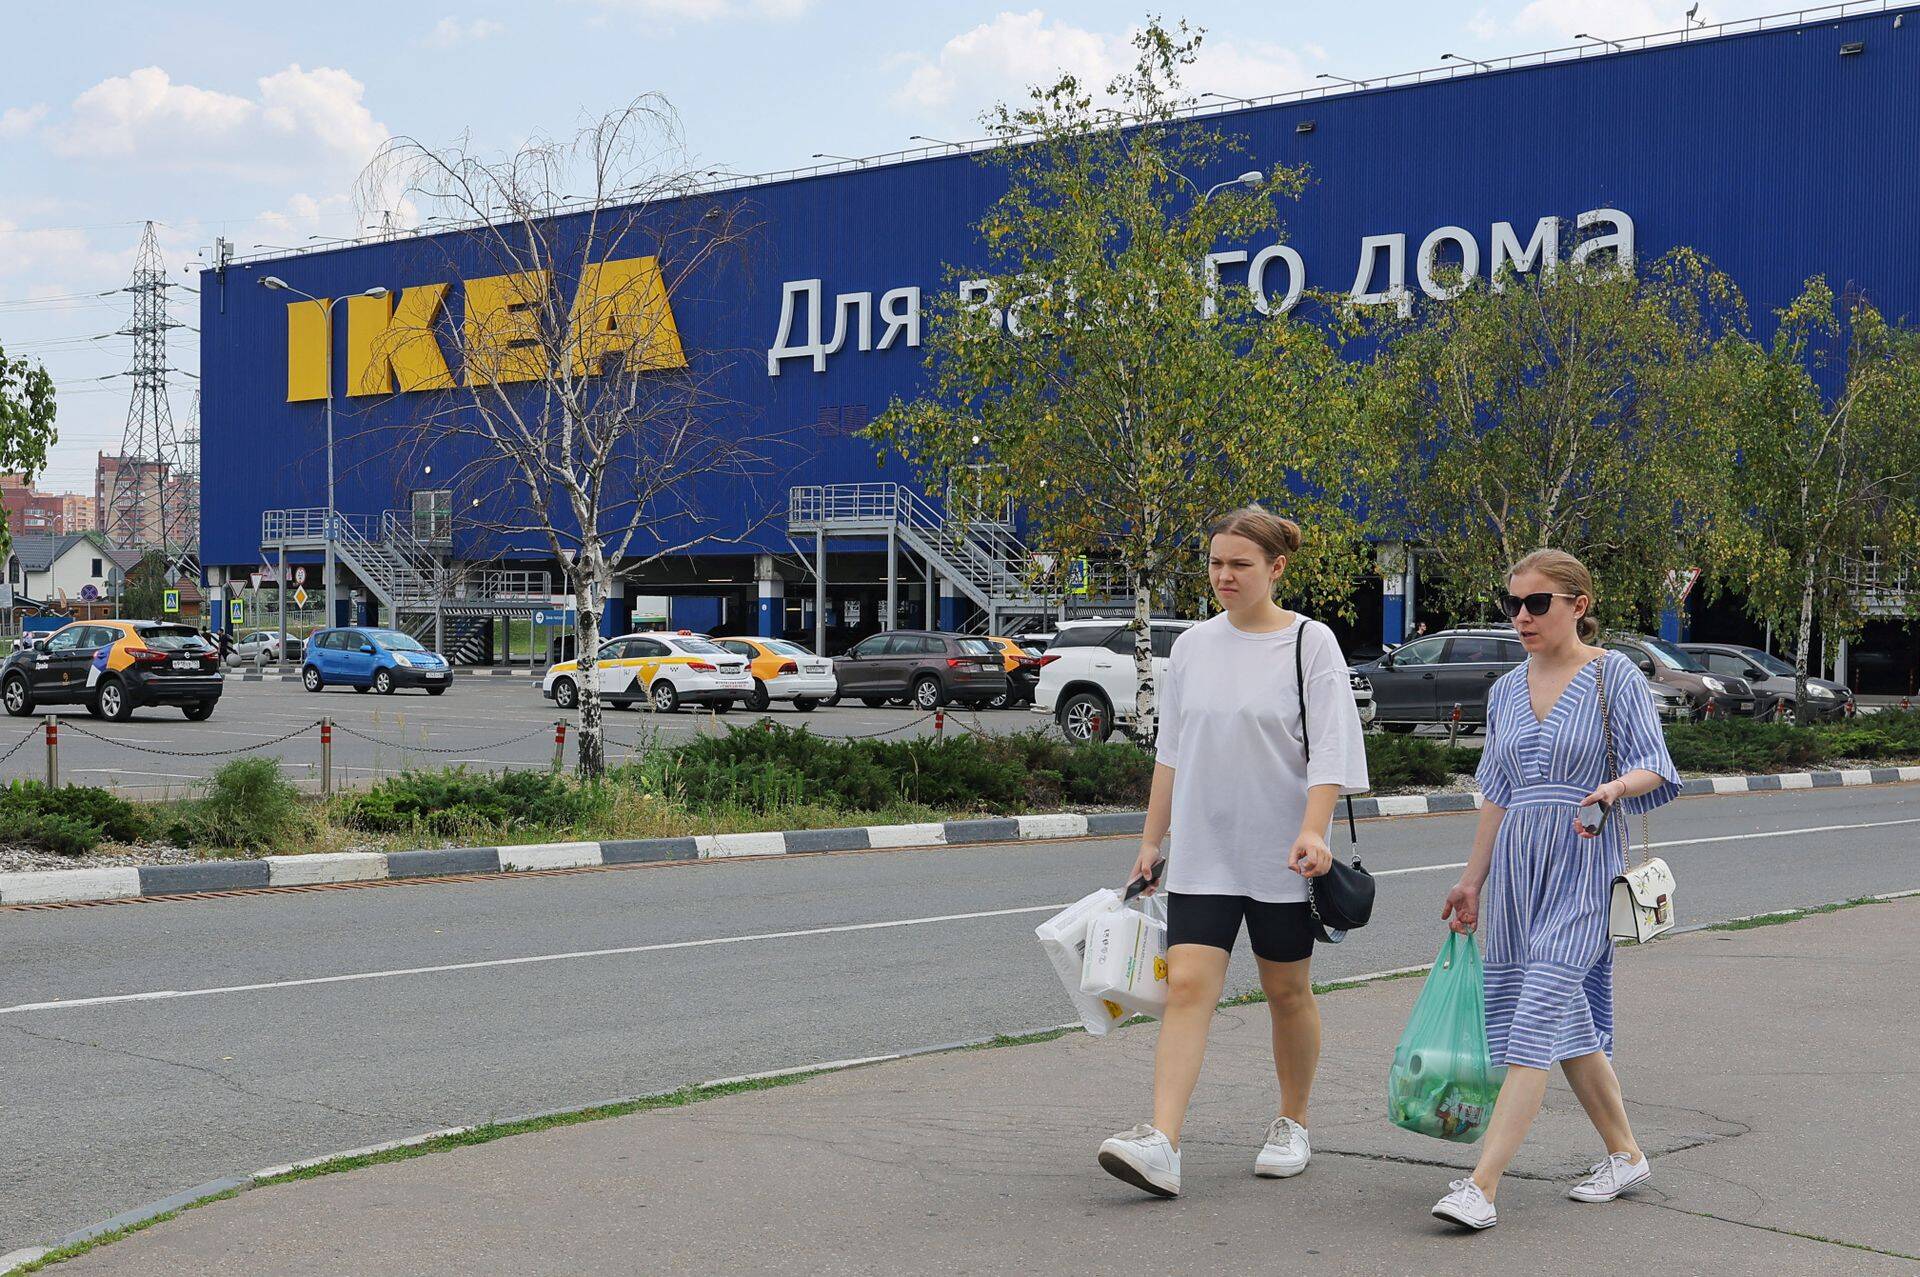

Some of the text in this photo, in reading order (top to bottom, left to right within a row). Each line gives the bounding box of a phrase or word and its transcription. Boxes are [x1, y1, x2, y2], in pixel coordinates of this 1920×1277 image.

[286, 256, 688, 402] IKEA
[768, 207, 1635, 376] Для ваго дома
